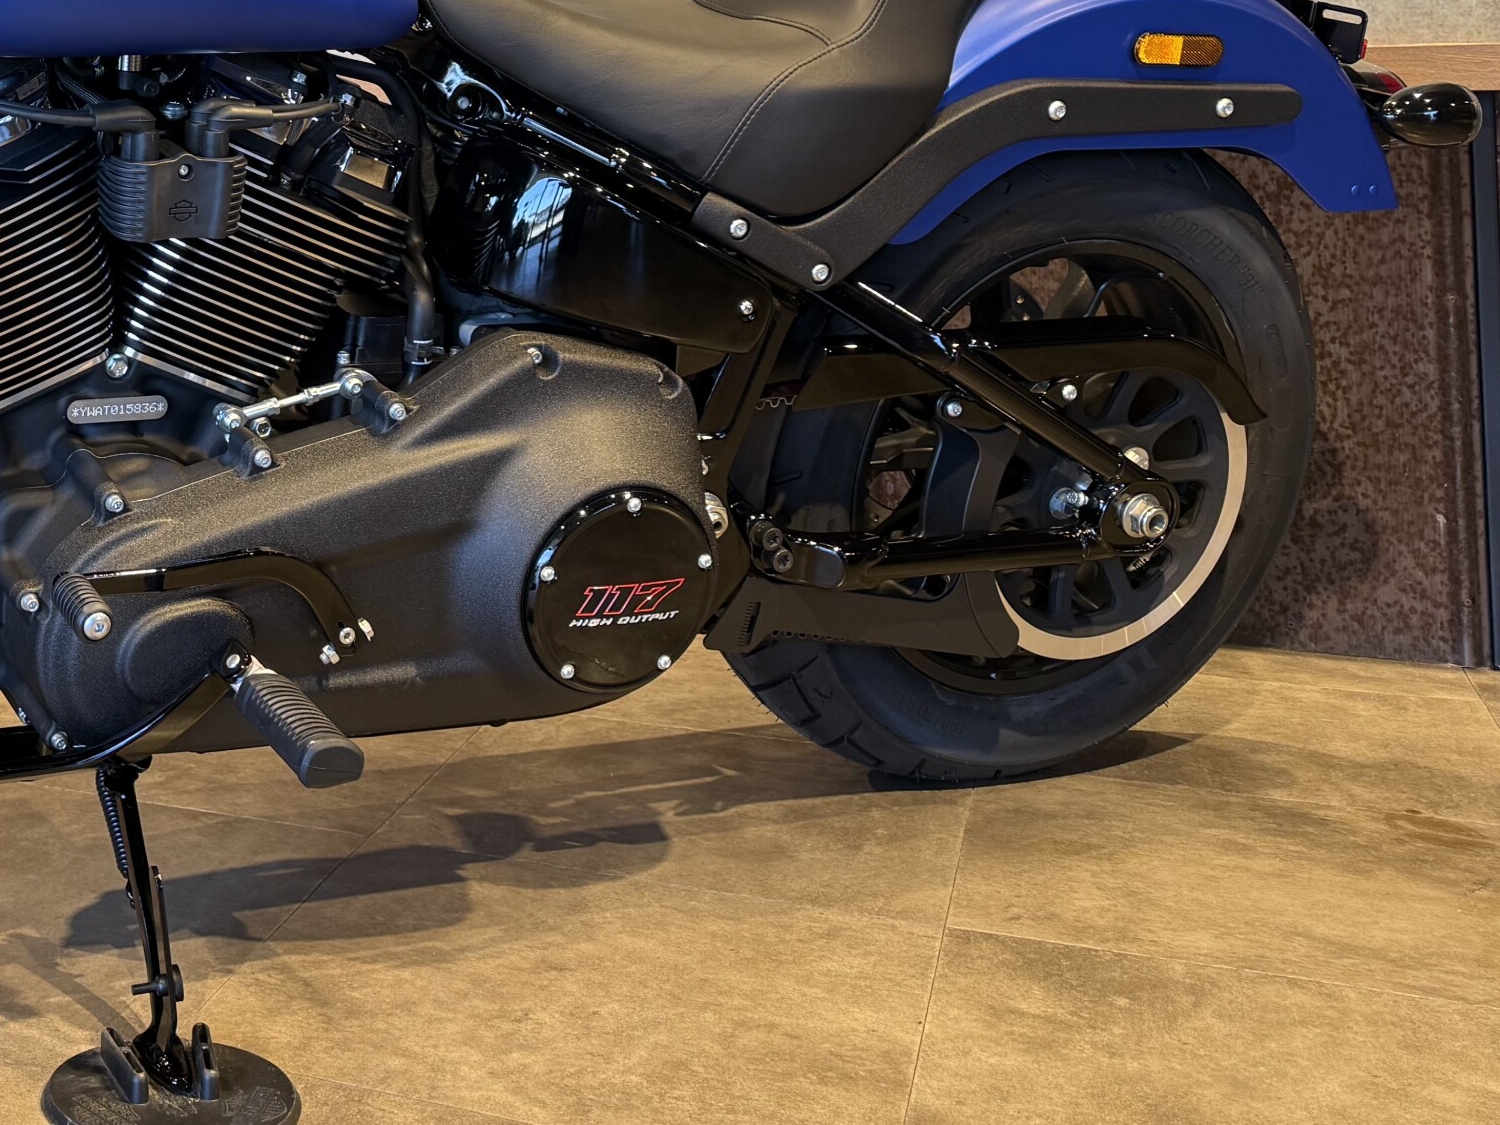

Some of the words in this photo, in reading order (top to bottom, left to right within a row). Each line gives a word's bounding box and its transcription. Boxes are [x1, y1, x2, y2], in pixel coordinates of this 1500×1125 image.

[576, 578, 685, 617] 117
[568, 617, 614, 628] HIGH
[616, 610, 680, 625] OUTPUT
